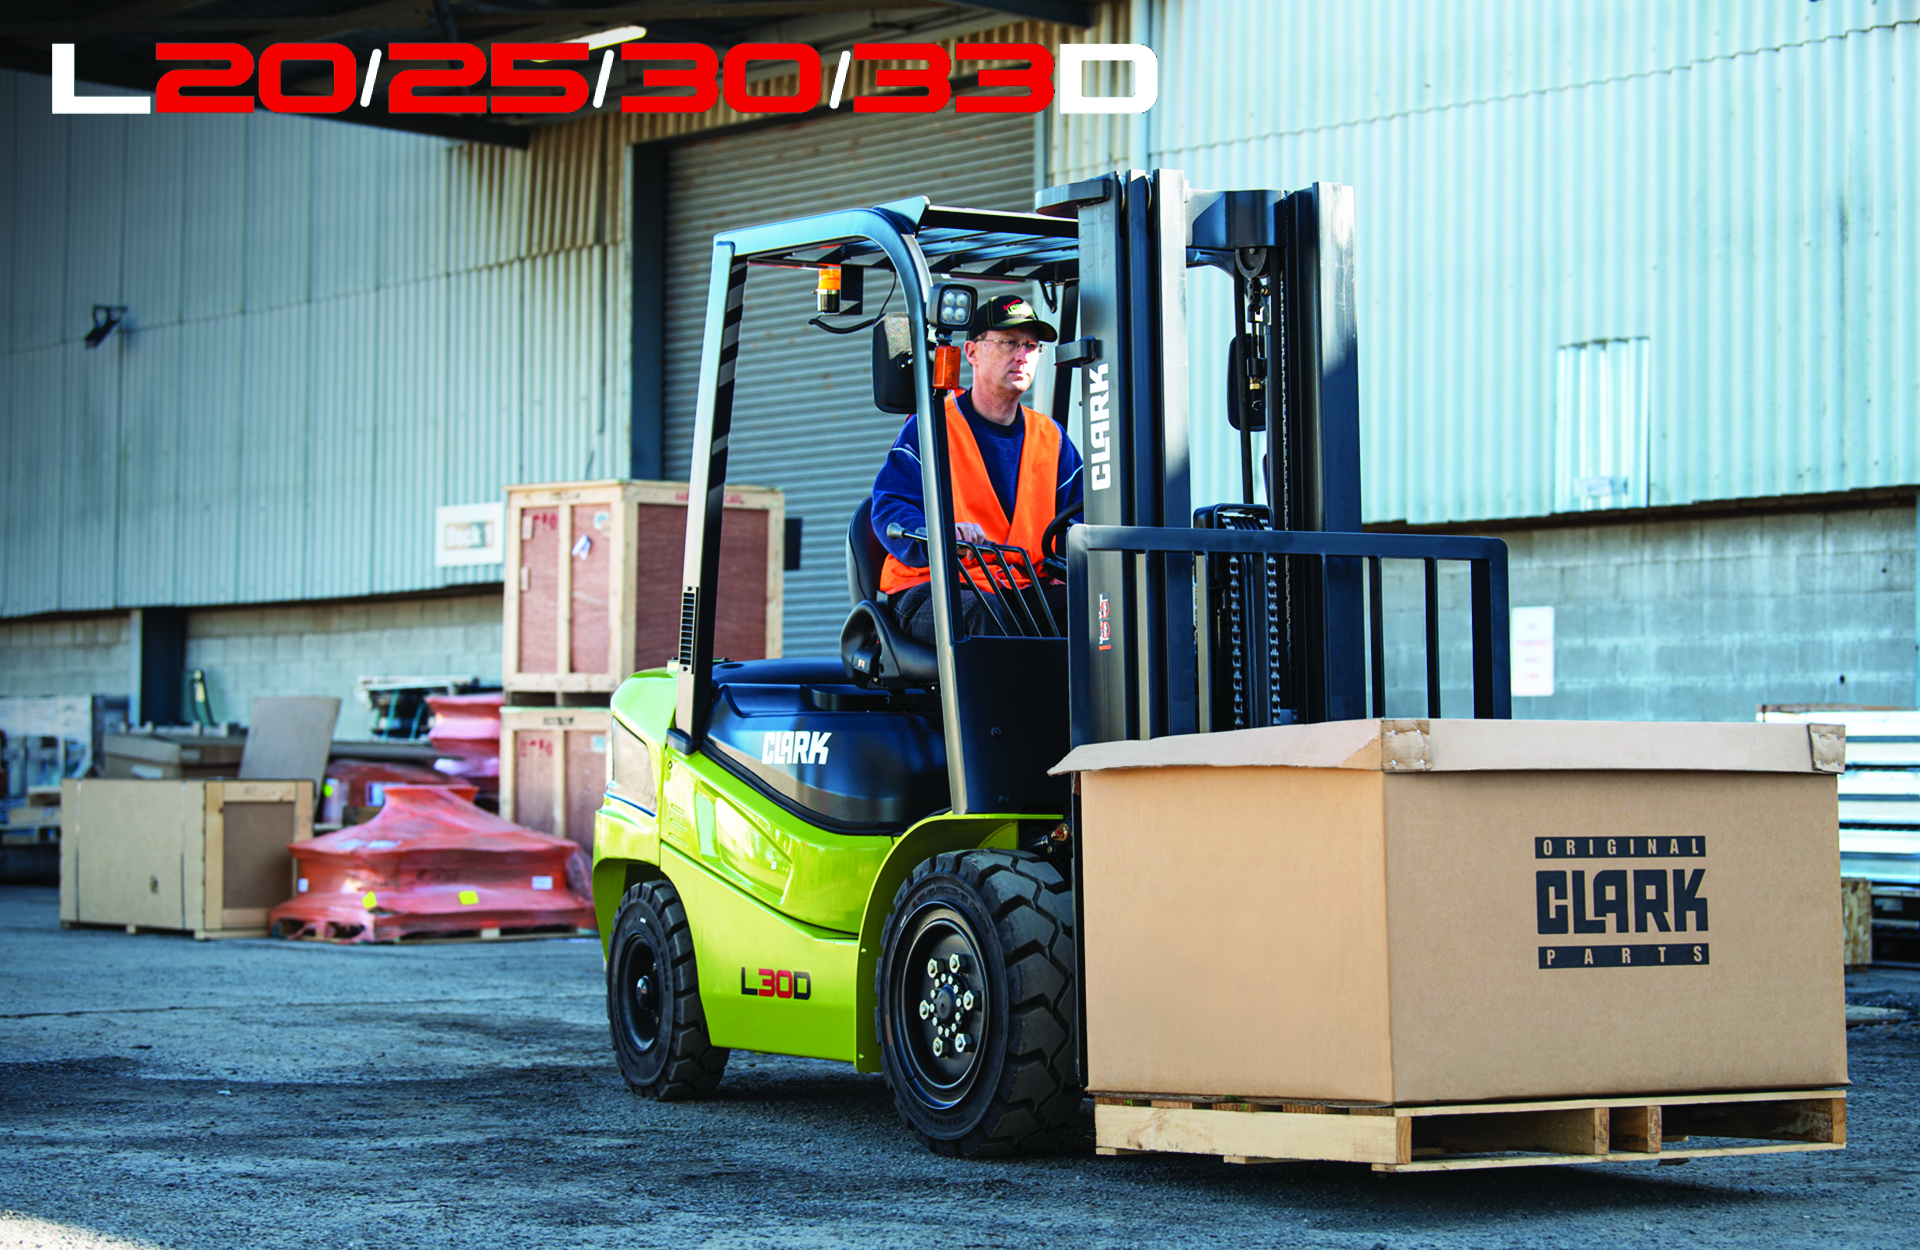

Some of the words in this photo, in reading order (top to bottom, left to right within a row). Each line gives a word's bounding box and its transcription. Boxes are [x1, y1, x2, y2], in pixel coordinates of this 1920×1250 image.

[1089, 363, 1111, 491] CLARK
[762, 731, 832, 765] CLARK
[1543, 838, 1699, 856] ORIGINAL
[1536, 868, 1708, 935] CLARK
[1546, 945, 1703, 966] PARTS
[741, 967, 811, 1001] L30D
